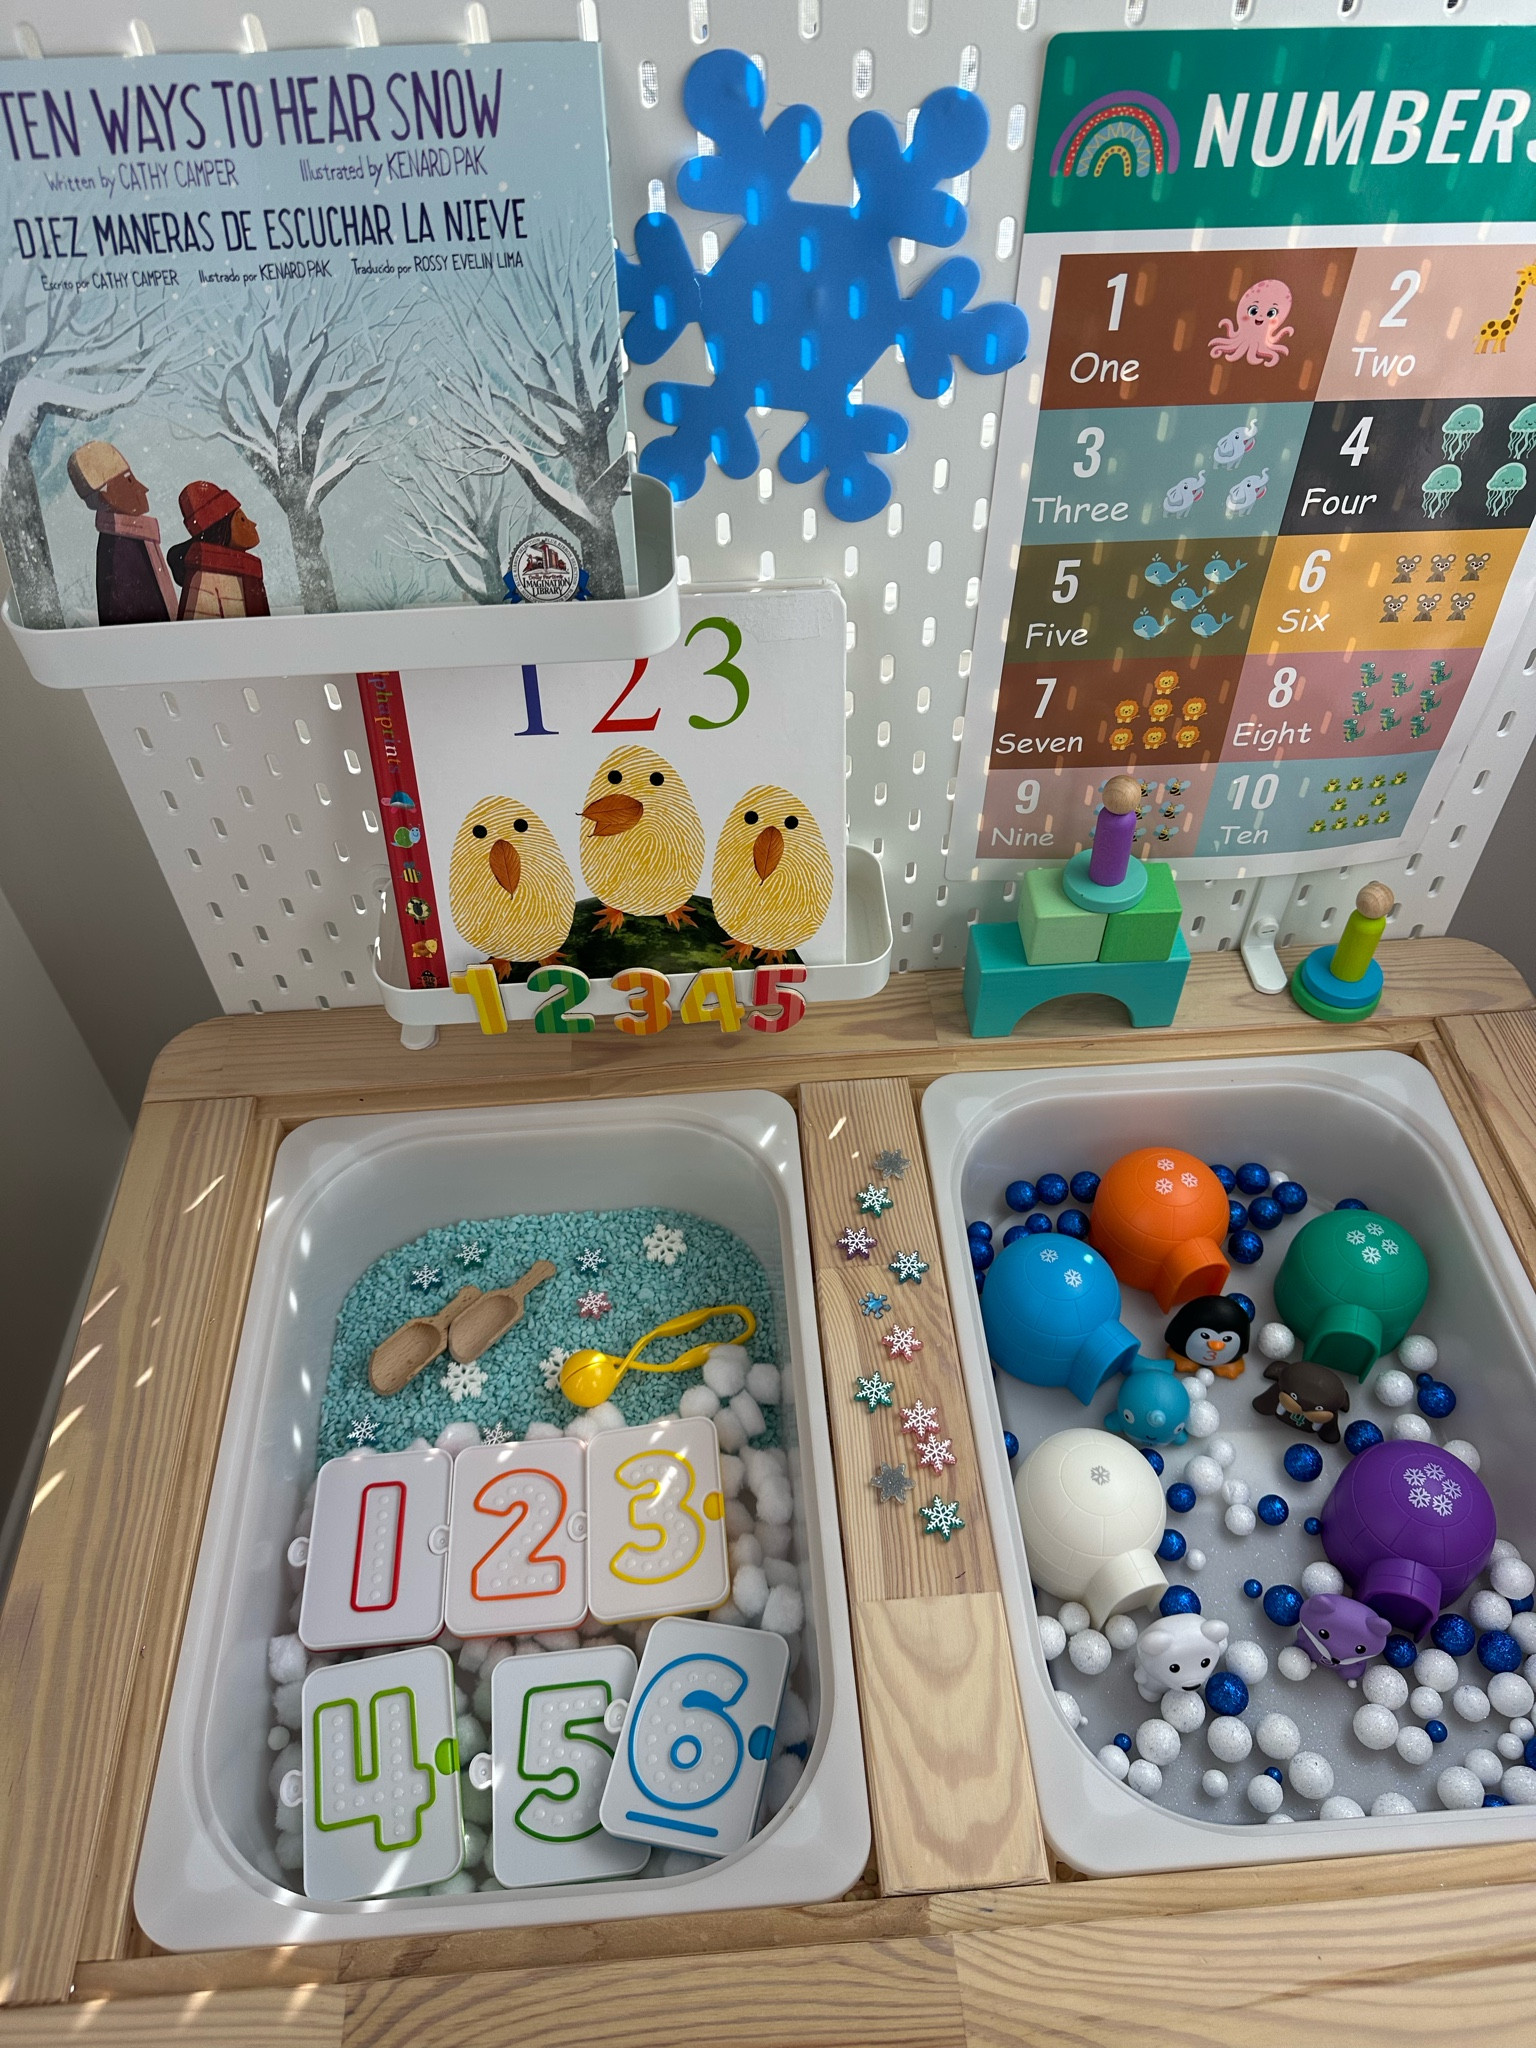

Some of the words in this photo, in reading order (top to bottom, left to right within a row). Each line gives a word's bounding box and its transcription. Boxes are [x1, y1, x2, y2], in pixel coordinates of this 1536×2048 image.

[0, 89, 80, 161] TEN
[89, 83, 206, 155] WAYS
[211, 80, 263, 149] TO
[270, 74, 381, 145] HEAR
[386, 68, 502, 141] SNOW
[1193, 88, 1536, 168] NUMBER
[44, 171, 96, 192] Written
[98, 167, 116, 199] by
[118, 162, 168, 191] CATHY
[174, 158, 239, 189] CAMPER
[299, 155, 364, 182] Illustrated
[366, 154, 383, 187] by
[385, 147, 451, 180] KENARD
[452, 145, 488, 176] PAK
[13, 216, 88, 260] DIEZ
[92, 211, 215, 257] MANERAS
[221, 210, 257, 252] DE
[263, 204, 394, 250] ESCUCHAR
[401, 201, 435, 244] LA
[443, 198, 528, 242] NIEVE
[40, 274, 74, 292] Escrito
[75, 279, 90, 294] por
[91, 271, 128, 290] CATHY
[132, 269, 180, 287] CAMPER
[198, 268, 241, 283] Ilustrado
[243, 273, 258, 287] por
[258, 261, 307, 282] KENARD
[308, 259, 333, 278] PAK
[351, 258, 395, 276] Traducido
[397, 263, 412, 279] por
[413, 255, 448, 273] ROSSY
[453, 251, 493, 271] EVELIN
[497, 250, 524, 269] LIMA
[1106, 272, 1128, 332] 1
[1378, 269, 1422, 328] 2
[1069, 350, 1141, 384] One
[1350, 346, 1416, 378] Two
[1072, 426, 1105, 478] 3
[1339, 415, 1374, 468] 4
[1031, 495, 1130, 524] Three
[1300, 487, 1377, 517] Four
[522, 577, 570, 589] IMAGINATION
[532, 587, 563, 597] LIBRARY
[1051, 559, 1081, 604] 5
[1298, 549, 1331, 594] 6
[1024, 622, 1089, 650] Five
[1276, 608, 1331, 634] Six
[592, 657, 661, 733] 2
[684, 617, 750, 730] 3
[1267, 666, 1298, 709] 8
[1032, 677, 1058, 719] 7
[368, 671, 400, 773] lphaprints
[1231, 720, 1313, 752] Eight
[994, 732, 1084, 755] Seven
[1015, 779, 1041, 814] 9
[1230, 773, 1280, 811] 10
[990, 826, 1055, 848] Nine
[1219, 825, 1269, 846] Ten
[450, 964, 508, 1035] 1
[527, 965, 595, 1034] 2
[611, 967, 672, 1036] 3
[681, 966, 745, 1033] 4
[747, 964, 807, 1033] 5
[471, 1468, 567, 1601] 2
[609, 1449, 706, 1585] 3
[350, 1480, 406, 1612] 1
[628, 1653, 749, 1811] 6
[313, 1686, 436, 1852] 4
[514, 1679, 616, 1843] 5
